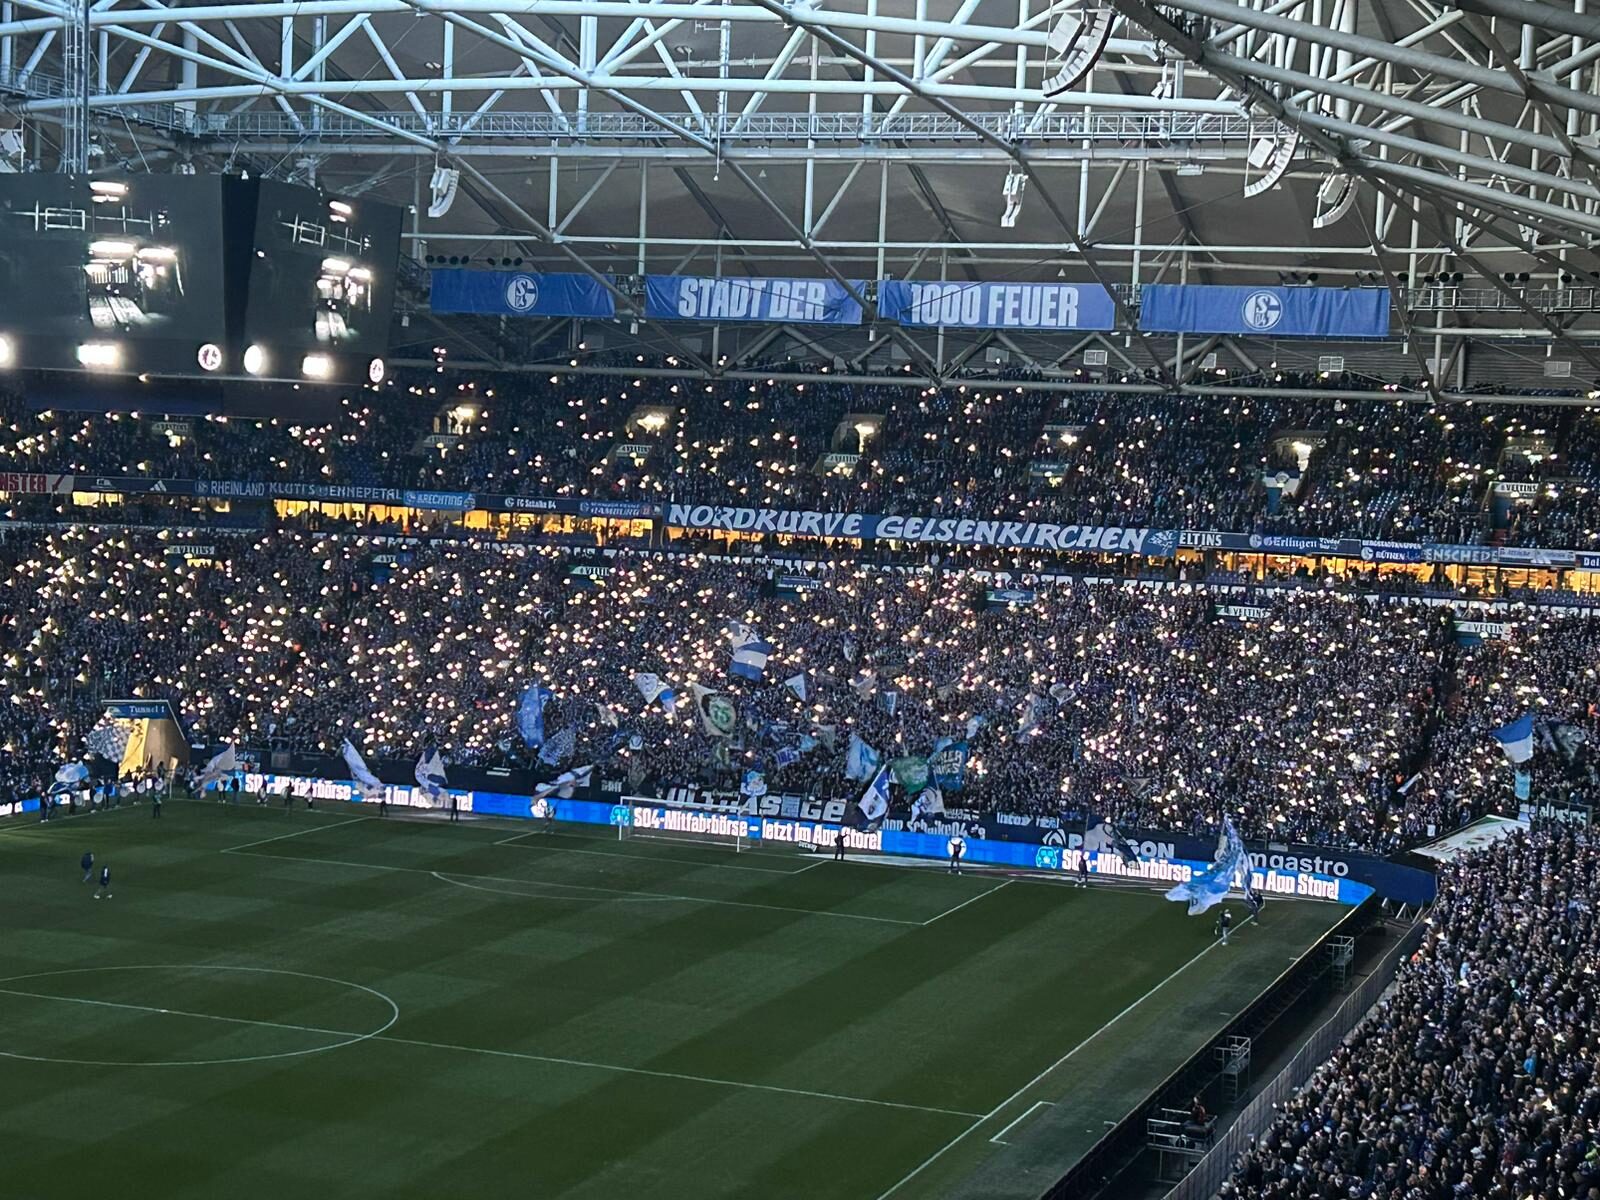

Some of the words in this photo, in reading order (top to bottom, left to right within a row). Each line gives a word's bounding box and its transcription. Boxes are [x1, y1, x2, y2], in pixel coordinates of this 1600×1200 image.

[678, 278, 767, 318] STADT
[768, 279, 826, 321] DER
[910, 284, 982, 325] 1000
[987, 285, 1079, 327] FEUER
[211, 480, 265, 497] RHEINLAND
[329, 485, 402, 501] ENNEPETAL
[668, 503, 863, 536] NORDKURVE
[875, 515, 1149, 553] GELSENKIRCHEN
[1179, 532, 1222, 547] ELTINS
[1473, 623, 1503, 634] VELTIN
[129, 705, 159, 713] Tunnel
[633, 807, 748, 837] S04-Mitfahrbörse
[1249, 852, 1349, 876] mgastro
[1265, 870, 1296, 894] App
